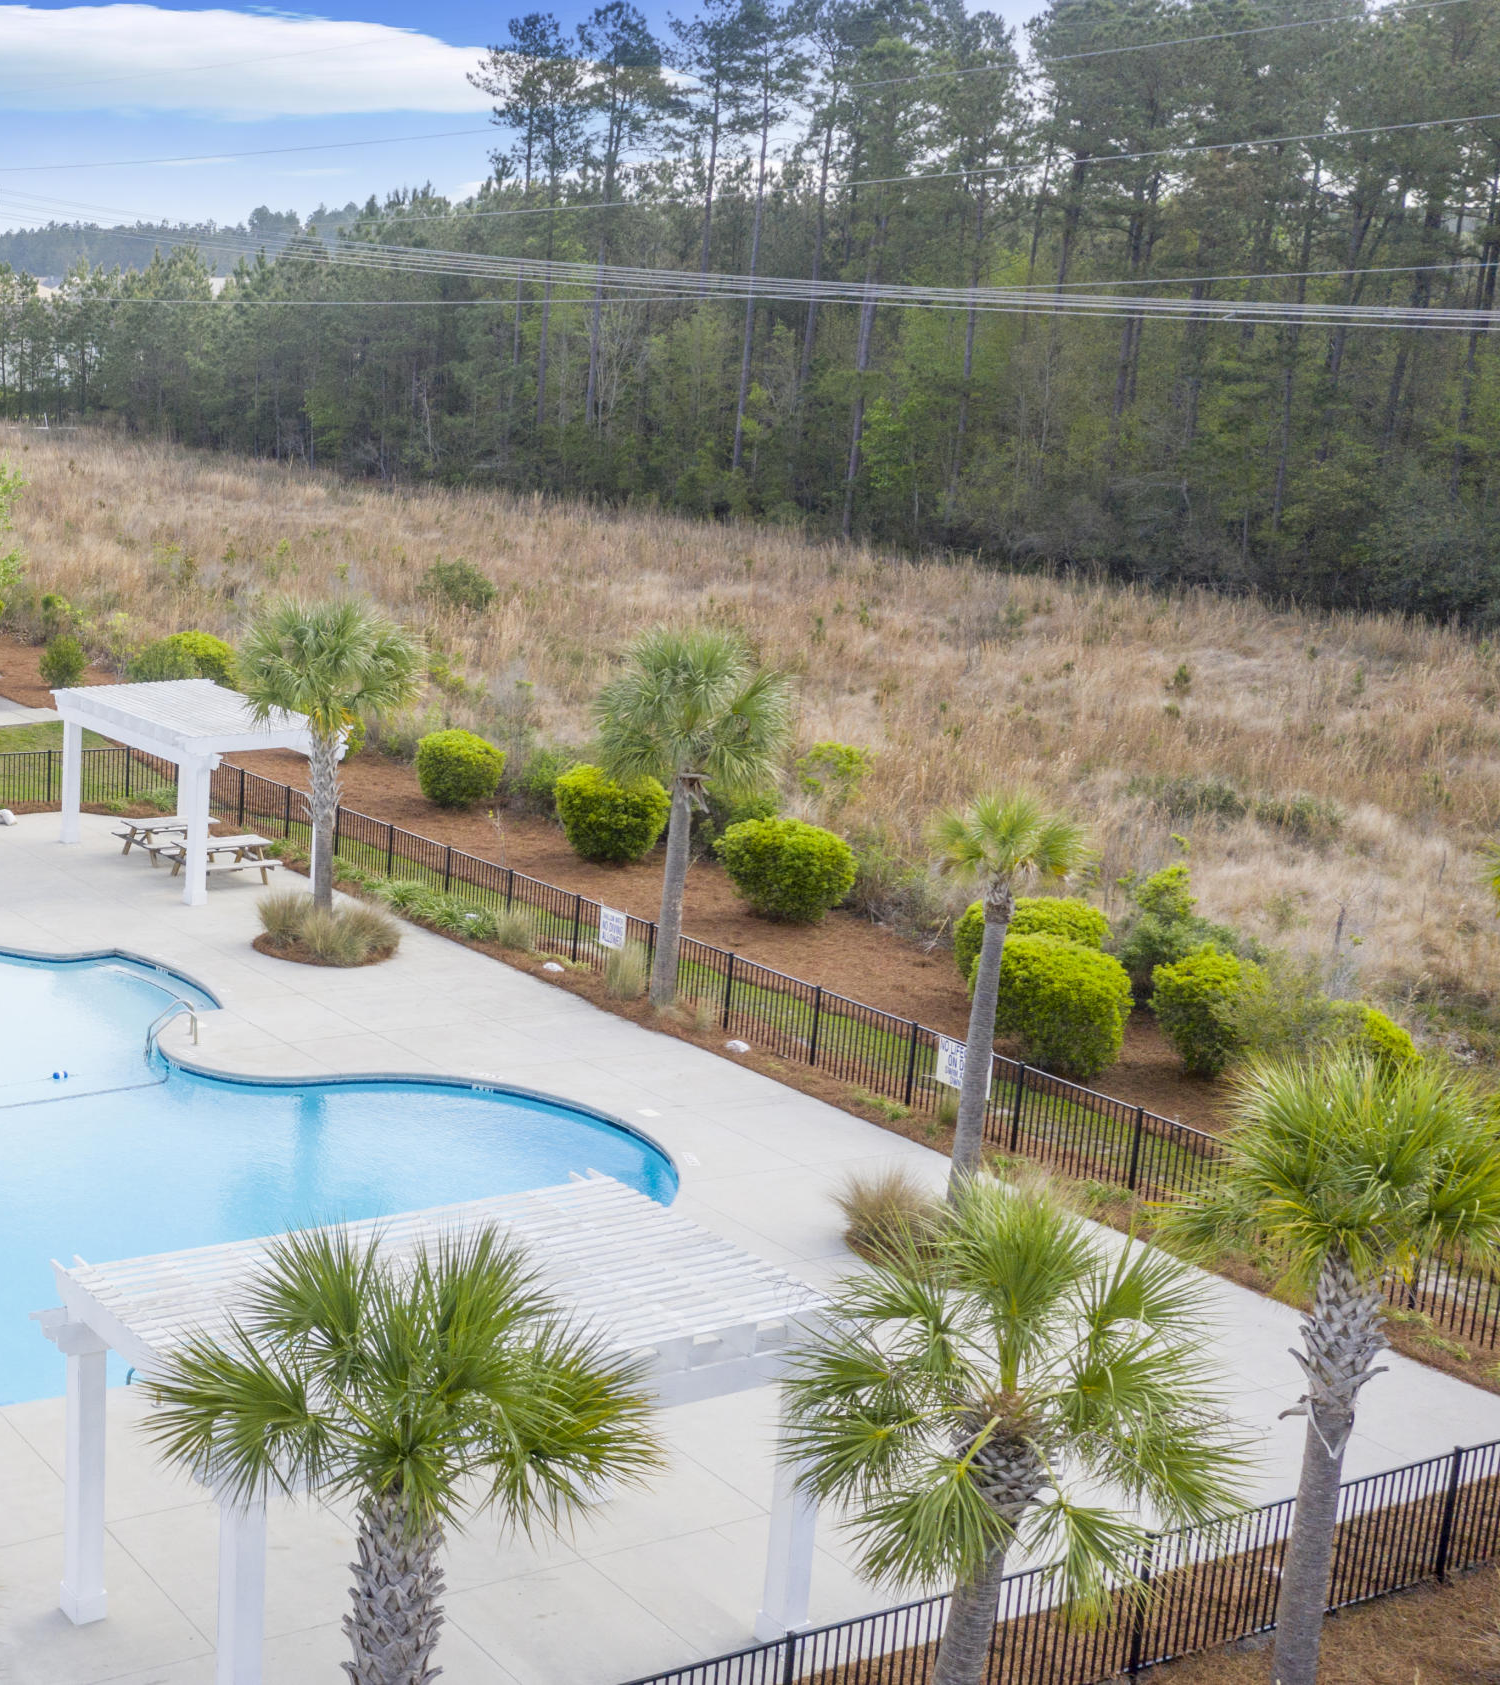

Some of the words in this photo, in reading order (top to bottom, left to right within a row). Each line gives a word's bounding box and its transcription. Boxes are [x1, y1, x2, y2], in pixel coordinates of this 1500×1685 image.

[602, 920, 608, 930] NO
[609, 922, 623, 936] DIVING
[940, 1037, 949, 1052] NO
[948, 1054, 957, 1068] ON
